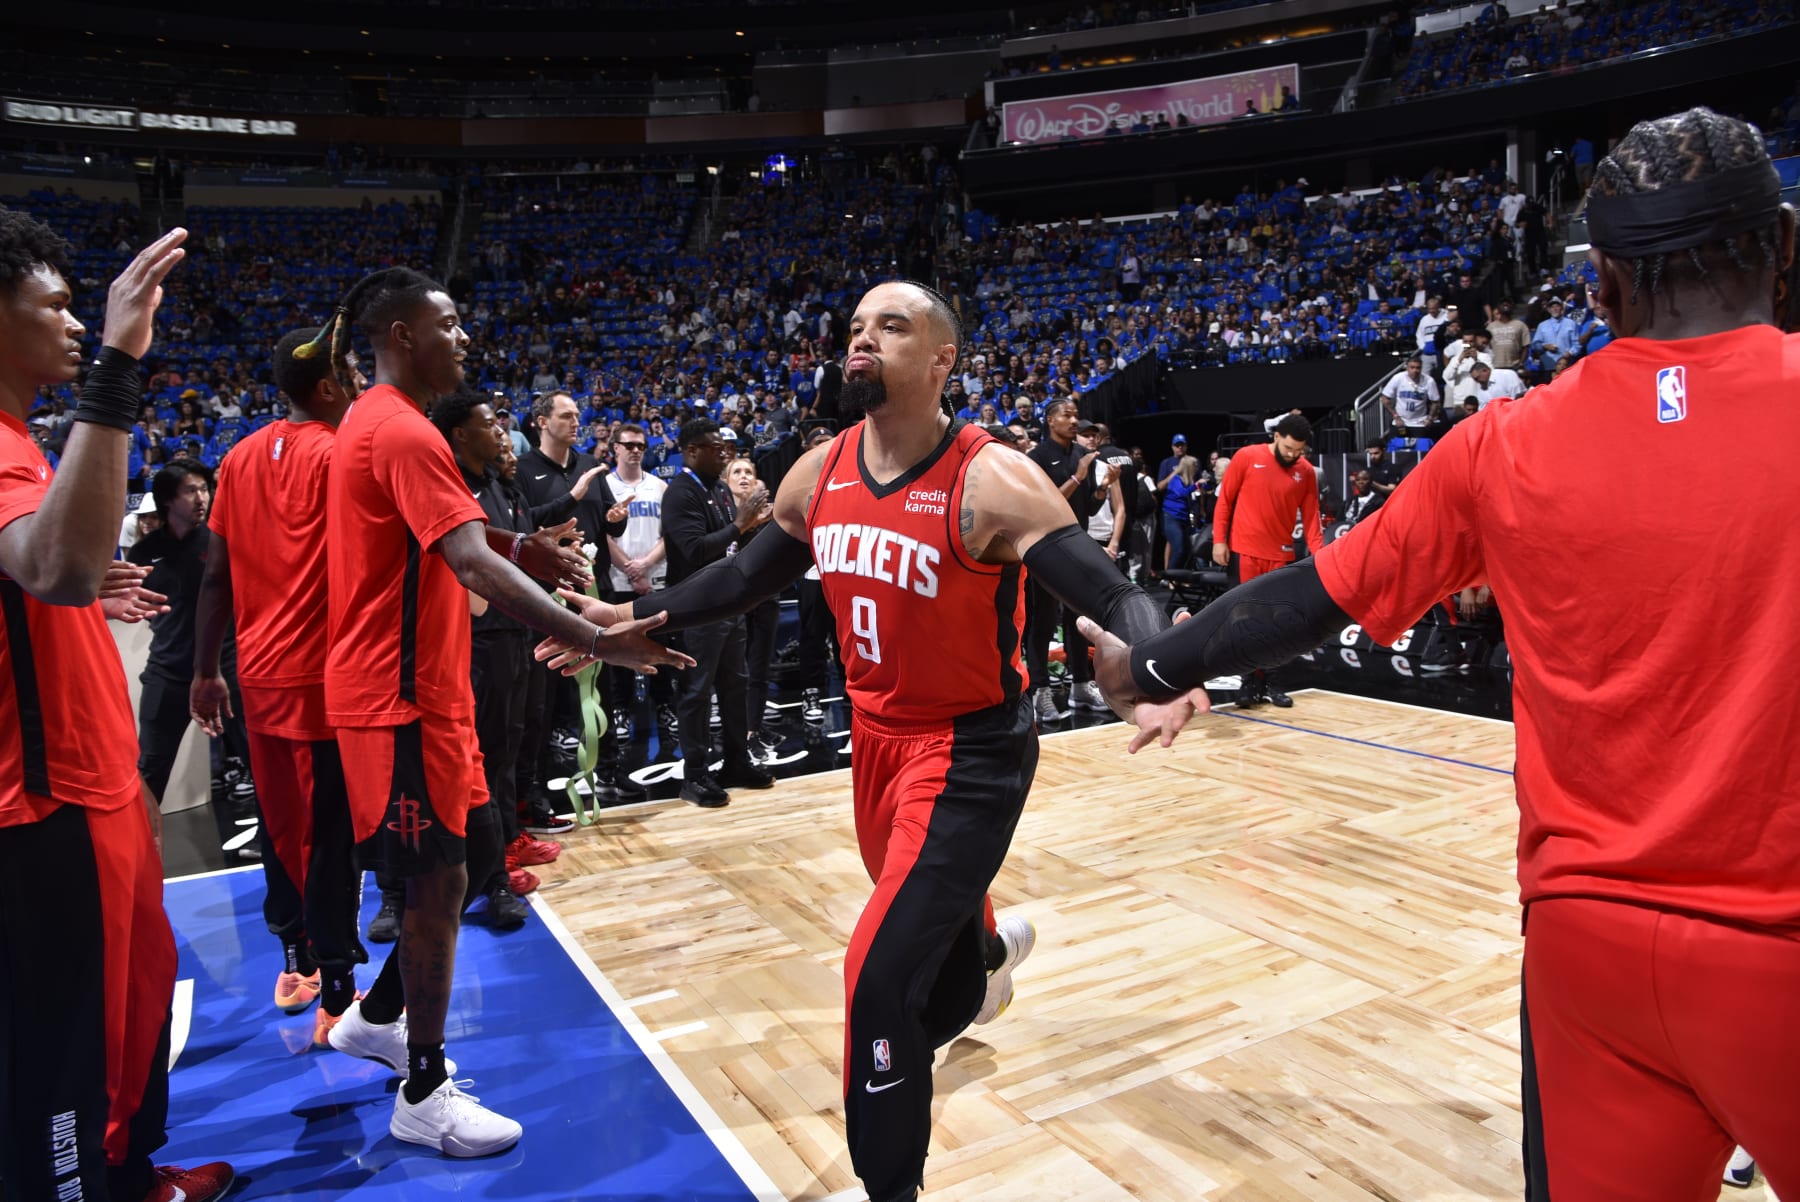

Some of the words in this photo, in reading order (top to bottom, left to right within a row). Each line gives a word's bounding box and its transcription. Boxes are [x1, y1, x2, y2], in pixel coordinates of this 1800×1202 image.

[7, 101, 61, 121] BUD
[62, 106, 135, 126] LIGHT
[140, 112, 248, 134] BASELINE
[250, 119, 297, 136] BAR
[904, 499, 945, 515] karma
[909, 488, 947, 503] credit
[629, 501, 660, 519] AGIC
[812, 523, 941, 599] ROCKETS
[852, 595, 882, 665] 9
[1340, 623, 1362, 646] G
[1391, 628, 1416, 652] G
[52, 1109, 79, 1176] HOUSTON
